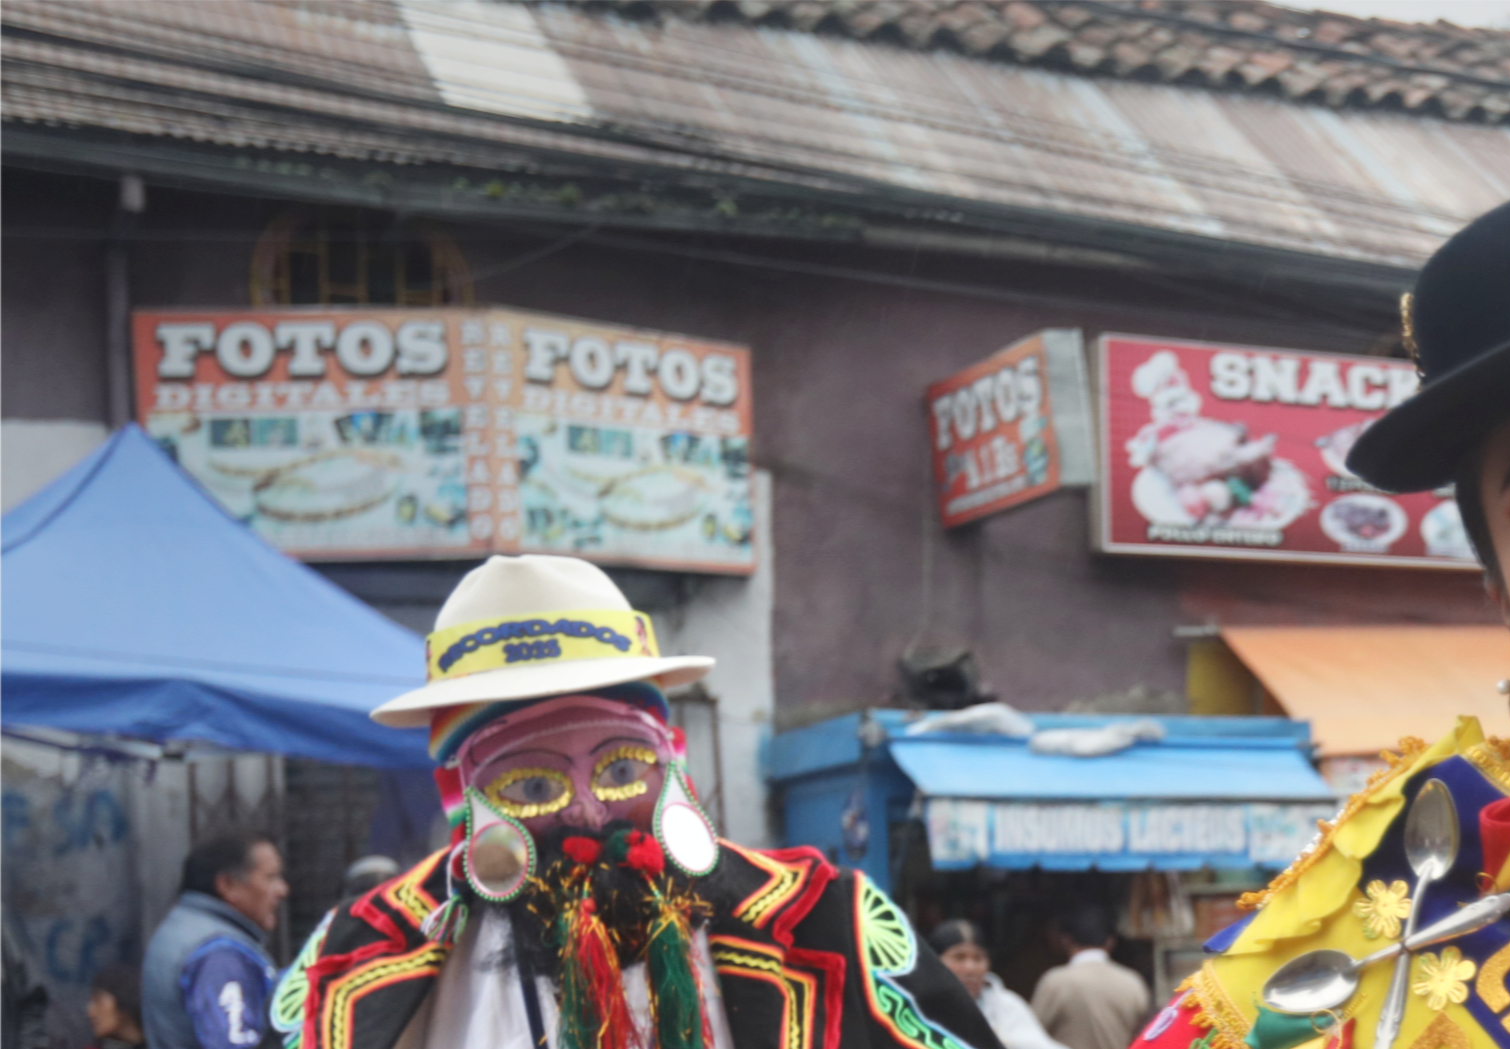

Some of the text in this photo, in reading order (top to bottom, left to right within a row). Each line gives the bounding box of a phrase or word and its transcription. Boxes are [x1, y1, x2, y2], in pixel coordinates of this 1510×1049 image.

[155, 320, 447, 378] FOTOS
[524, 328, 740, 406] FOTOS
[153, 380, 449, 412] DIGITALES
[522, 384, 741, 433] DIGITALES
[934, 355, 1040, 450] FOTOS
